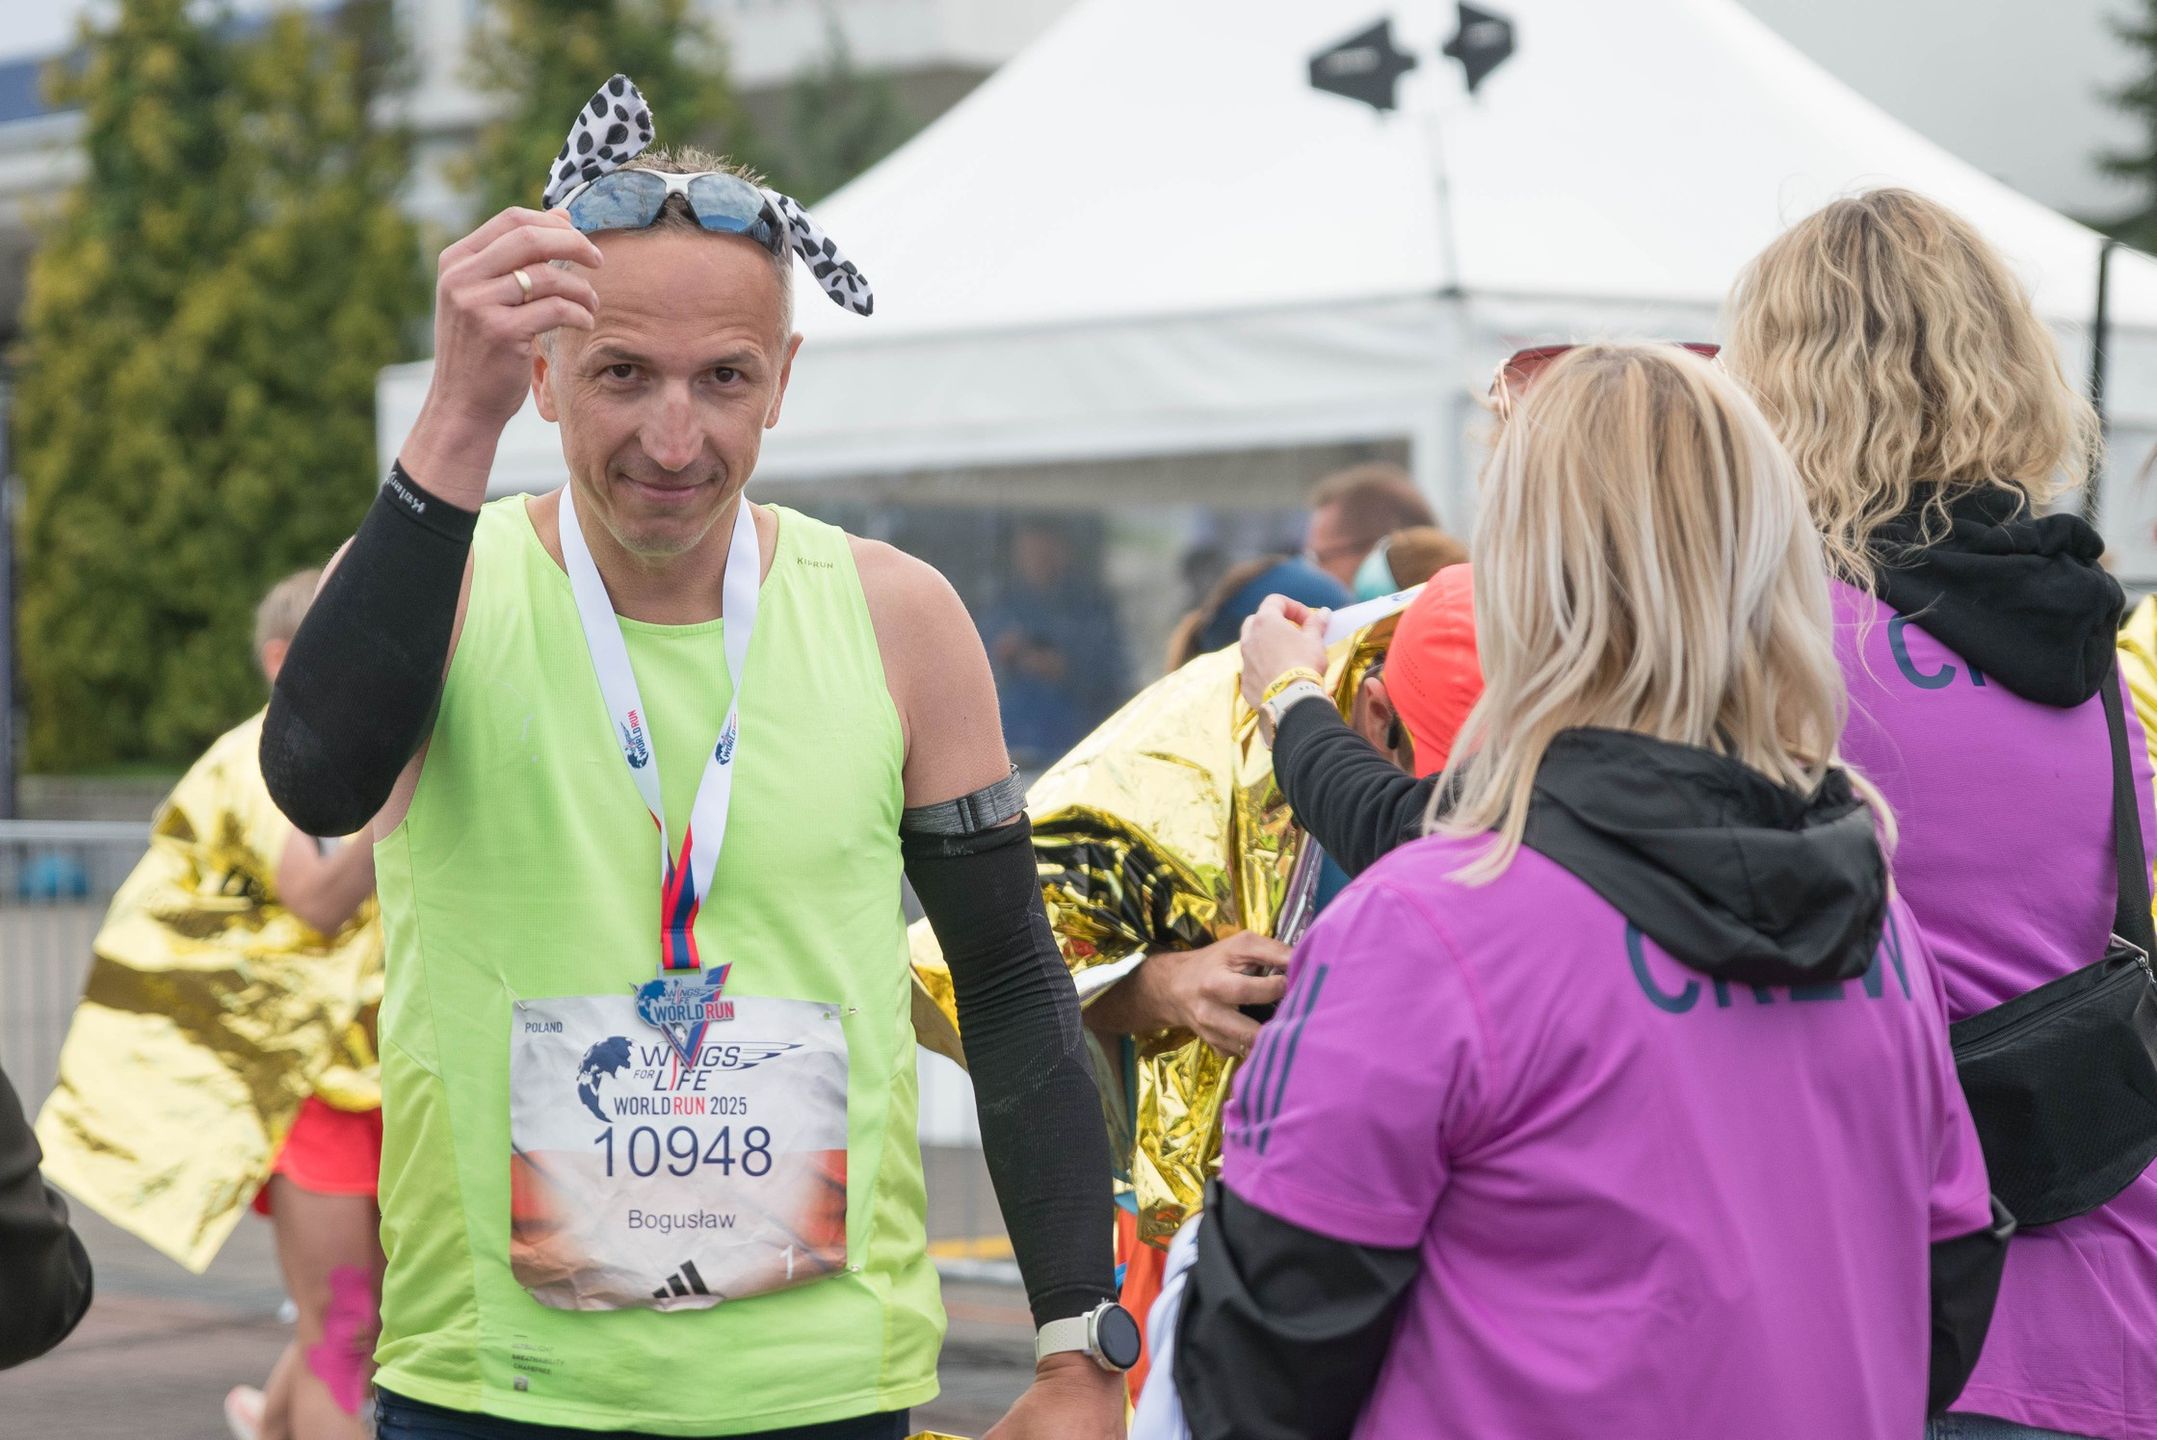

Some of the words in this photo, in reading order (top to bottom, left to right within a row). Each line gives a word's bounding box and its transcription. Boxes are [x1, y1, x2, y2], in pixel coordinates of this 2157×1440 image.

[633, 727, 647, 758] WORLD
[654, 1003, 704, 1021] WORLD
[705, 1001, 735, 1019] RUN
[525, 1021, 563, 1033] POLAND
[633, 1070, 655, 1080] FOR
[653, 1070, 712, 1091] LIFE
[614, 1096, 670, 1115] WORLD
[673, 1096, 705, 1115] RUN
[710, 1096, 747, 1115] 2025
[594, 1125, 772, 1177] 10948
[628, 1209, 736, 1234] Bogusław
[779, 1244, 793, 1280] 1
